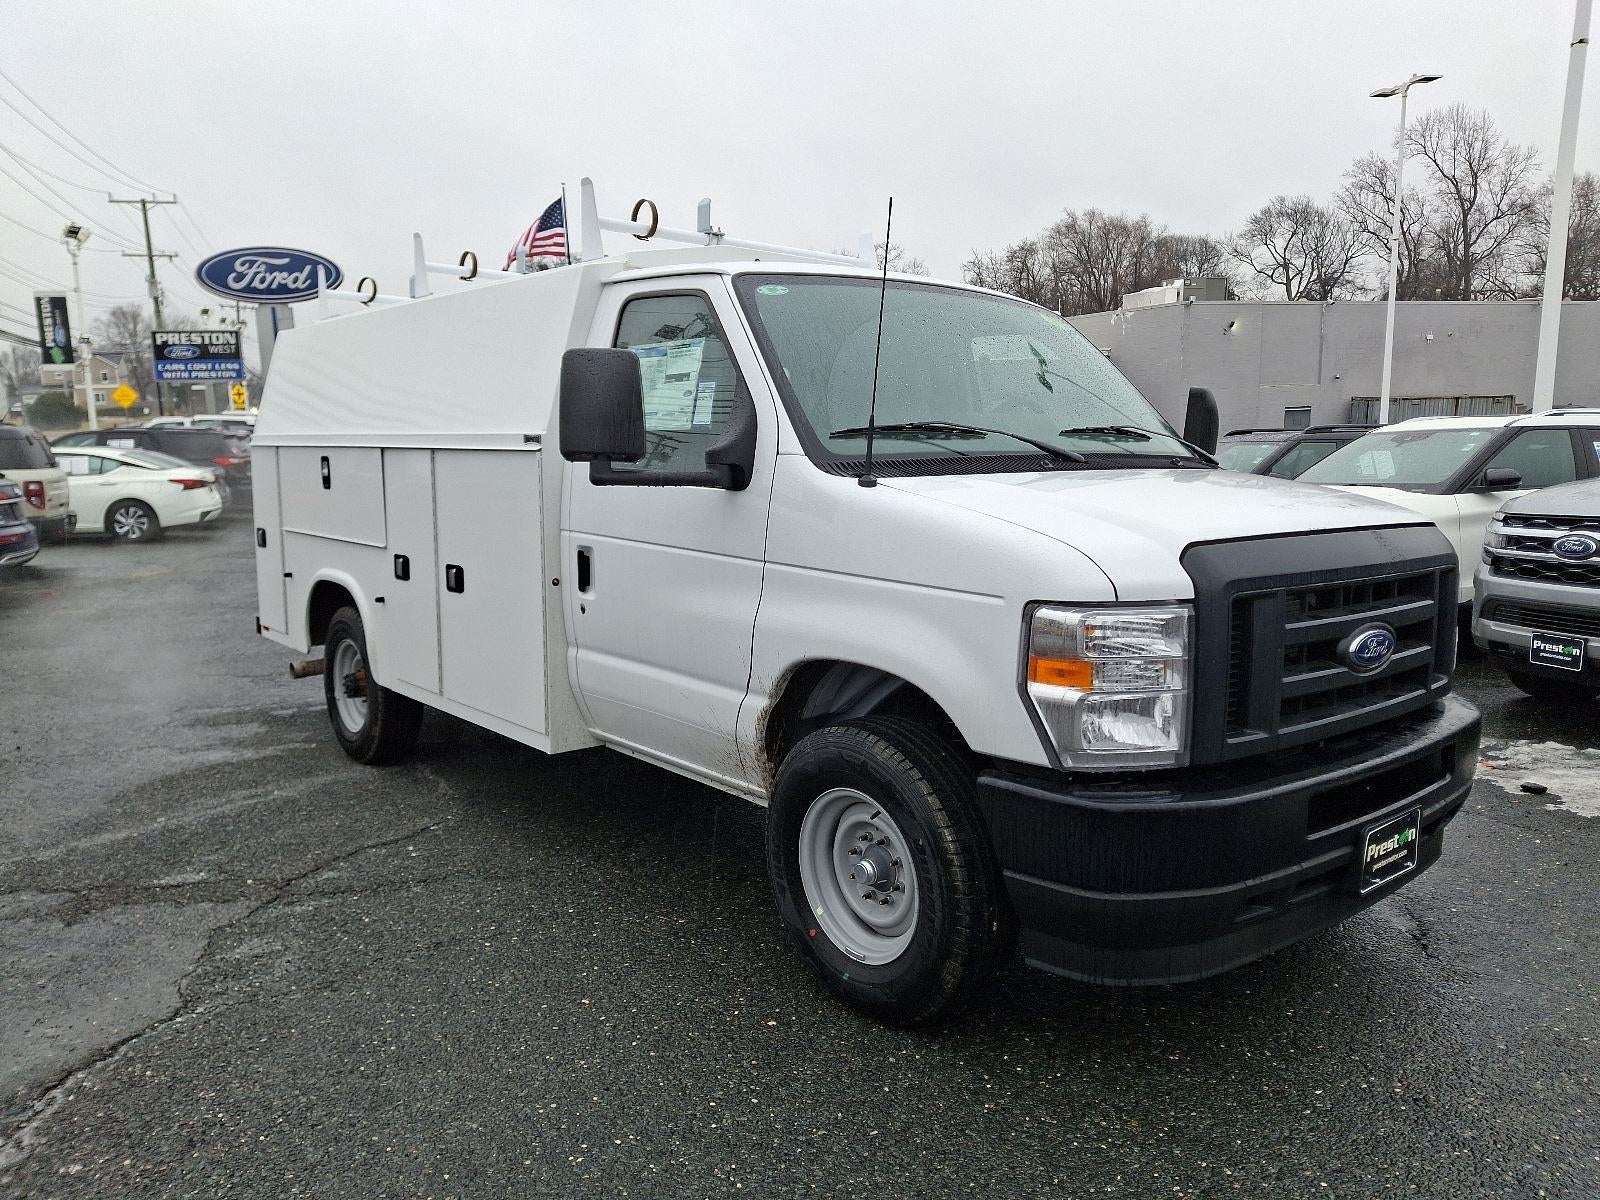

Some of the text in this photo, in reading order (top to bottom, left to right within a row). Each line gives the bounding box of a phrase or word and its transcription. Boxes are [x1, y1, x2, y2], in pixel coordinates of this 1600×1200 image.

[227, 255, 312, 290] Ford
[155, 332, 237, 345] PRESTON
[208, 345, 236, 354] WEST
[187, 363, 213, 371] COST
[162, 371, 237, 379] WITH PRESTON
[1365, 637, 1389, 657] Ford
[1533, 640, 1580, 656] Preston
[1367, 828, 1415, 862] Preston
